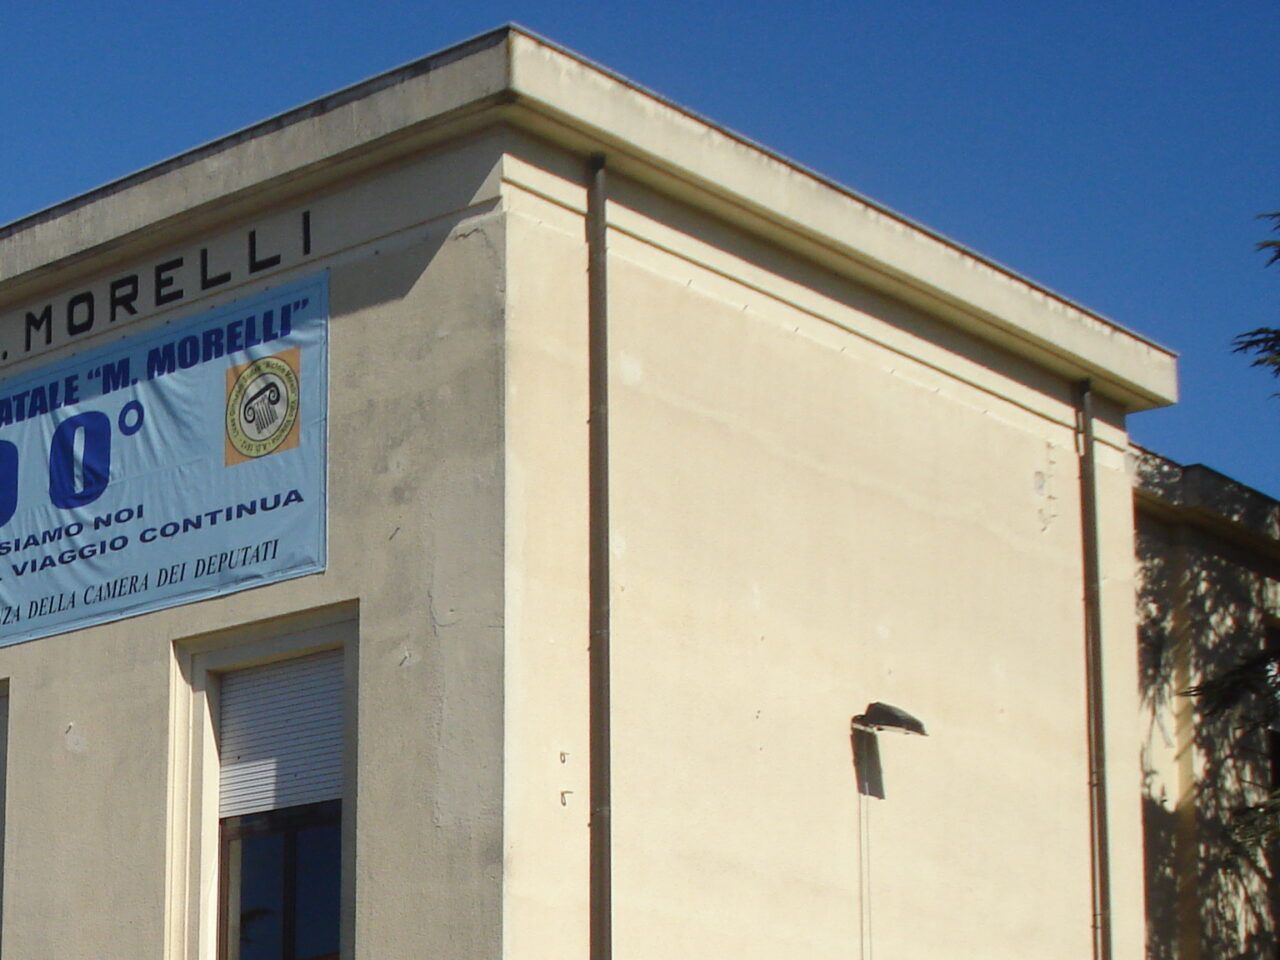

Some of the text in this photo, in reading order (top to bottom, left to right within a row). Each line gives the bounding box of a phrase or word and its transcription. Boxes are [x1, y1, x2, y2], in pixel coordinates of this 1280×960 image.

[11, 535, 128, 577] VIAGGIO
[139, 489, 304, 543] CONTINUA
[93, 504, 144, 531] NOI
[28, 592, 76, 621] DELLA
[84, 573, 149, 604] CAMERA
[157, 559, 186, 587] DEI
[194, 538, 280, 579] DEPUTATI
